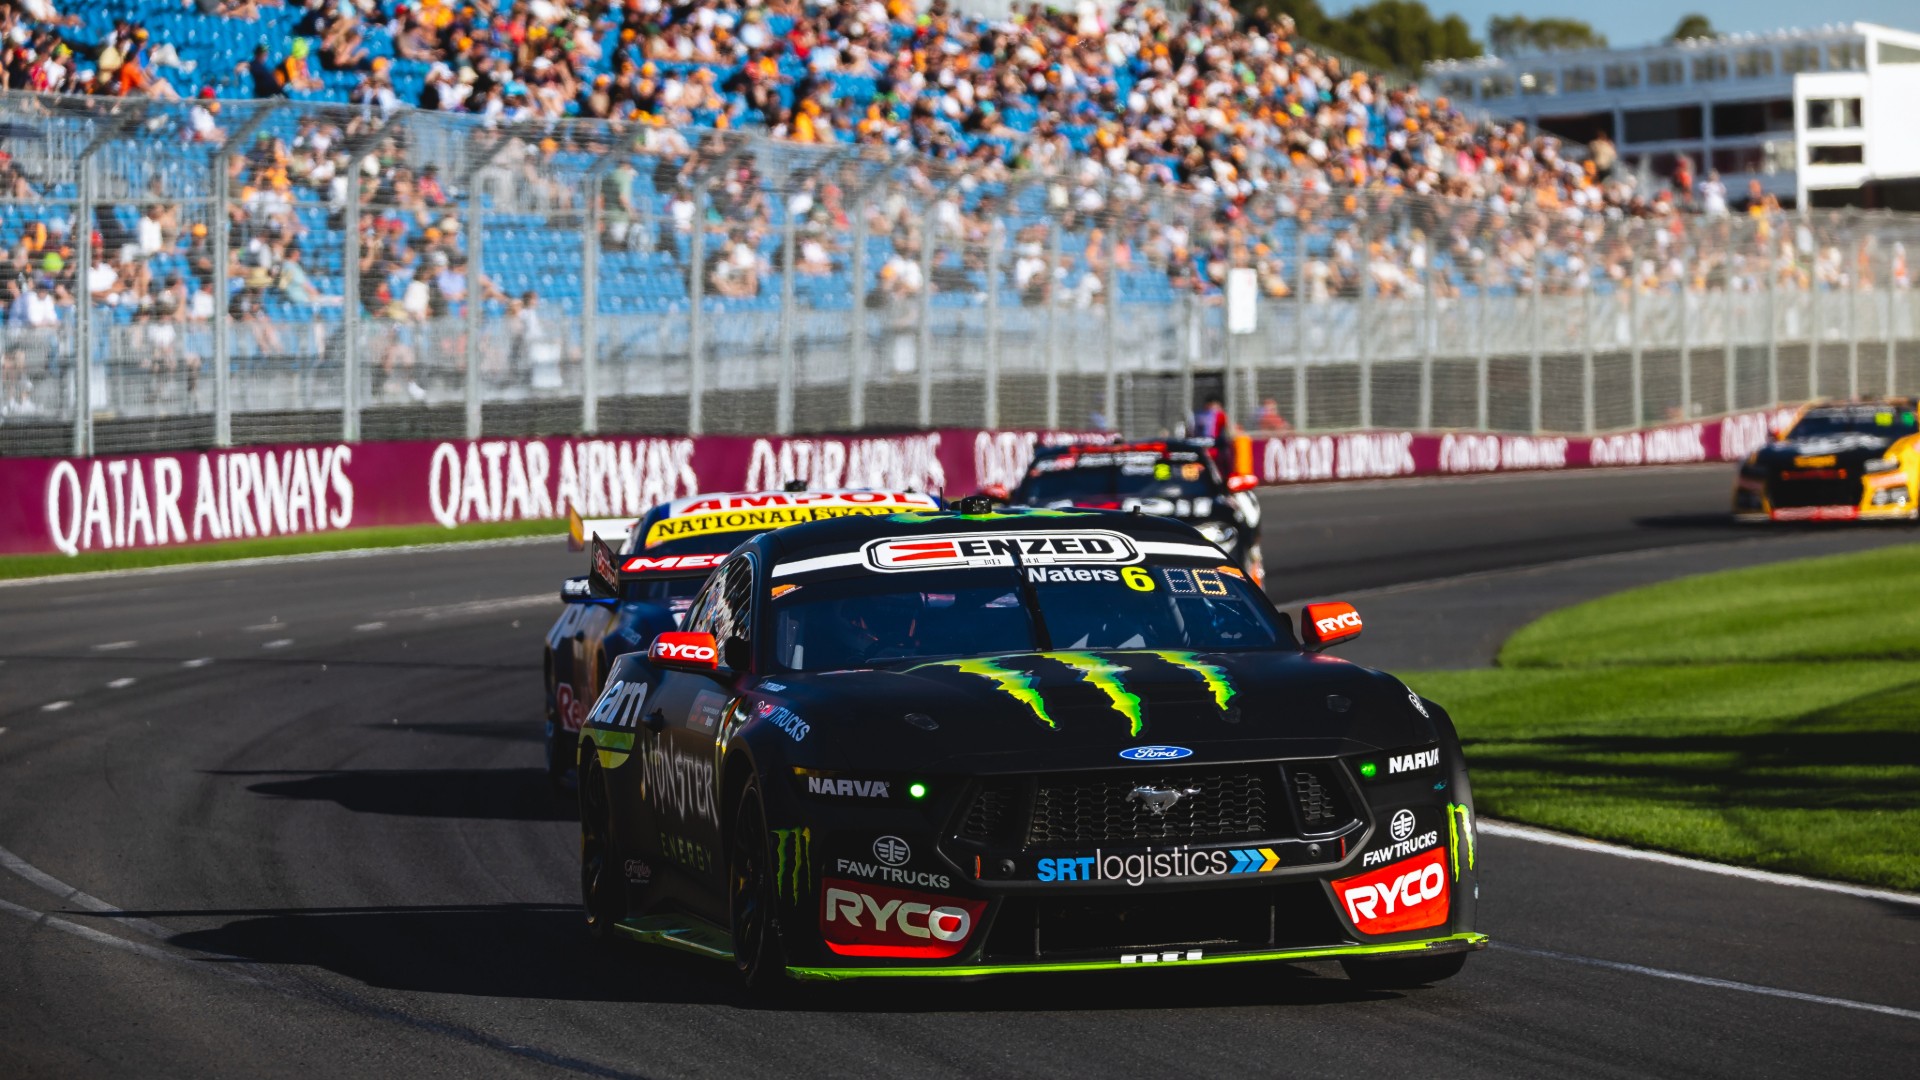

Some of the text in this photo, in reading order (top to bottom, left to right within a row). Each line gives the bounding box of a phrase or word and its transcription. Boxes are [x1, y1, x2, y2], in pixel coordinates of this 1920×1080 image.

[429, 438, 698, 528] QATAR AIRWAYS
[49, 444, 353, 557] QATAR AIRWAYS
[682, 491, 929, 514] AMPOL
[659, 509, 806, 537] NATIONAL
[958, 538, 1115, 557] ENZED
[1028, 566, 1155, 592] Naters 6
[1316, 611, 1362, 633] RYCO
[654, 642, 715, 660] RYCO
[588, 662, 648, 727] arn
[1134, 747, 1179, 758] Ford
[1389, 747, 1440, 774] NARVA
[641, 735, 719, 830] MONSTER
[808, 777, 890, 798] NARVA
[660, 832, 712, 874] ENERGY
[1363, 830, 1438, 867] FAW TRUCKS
[837, 858, 951, 889] FAW TRUCKS
[1345, 863, 1444, 923] RYCO
[826, 887, 971, 942] RYCO
